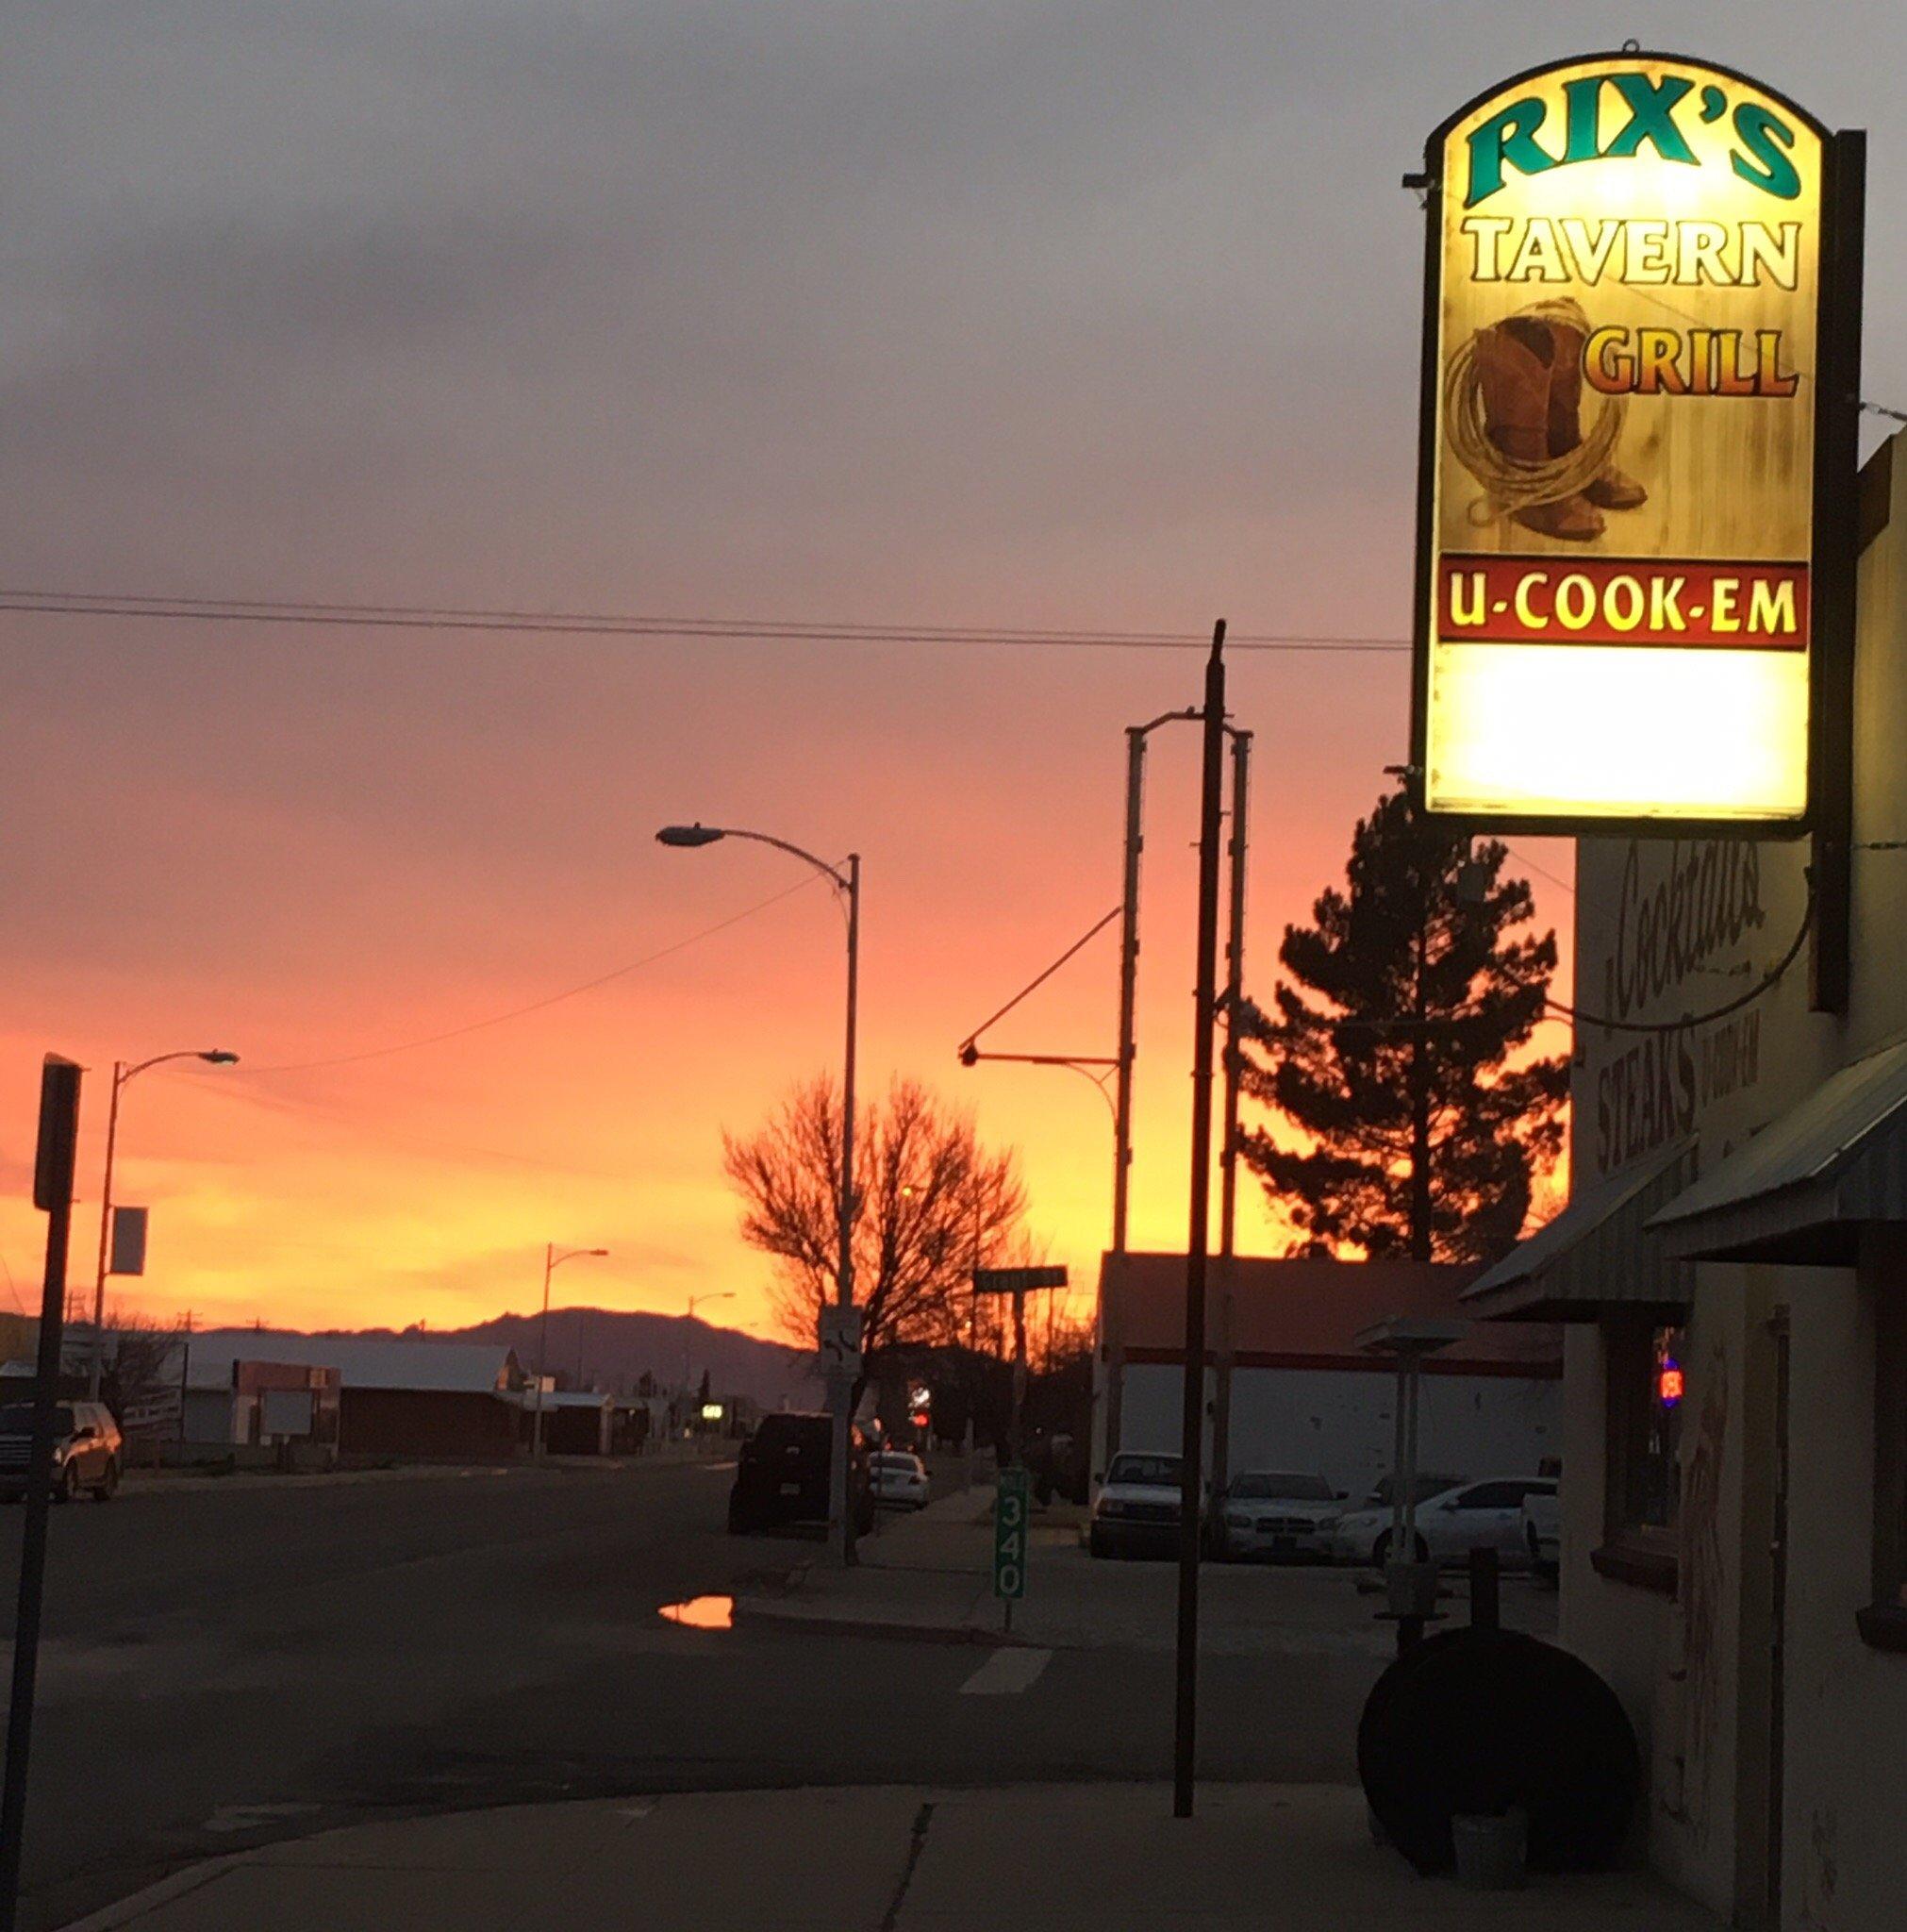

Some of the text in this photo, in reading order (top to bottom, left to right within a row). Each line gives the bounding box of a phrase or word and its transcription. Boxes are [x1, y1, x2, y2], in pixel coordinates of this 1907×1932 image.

[1463, 72, 1802, 208] RIX'S
[1460, 216, 1803, 291] TAVERN
[1581, 325, 1800, 397] GRILL
[1450, 572, 1798, 635] U-COOK-EM
[999, 1495, 1021, 1594] 340
